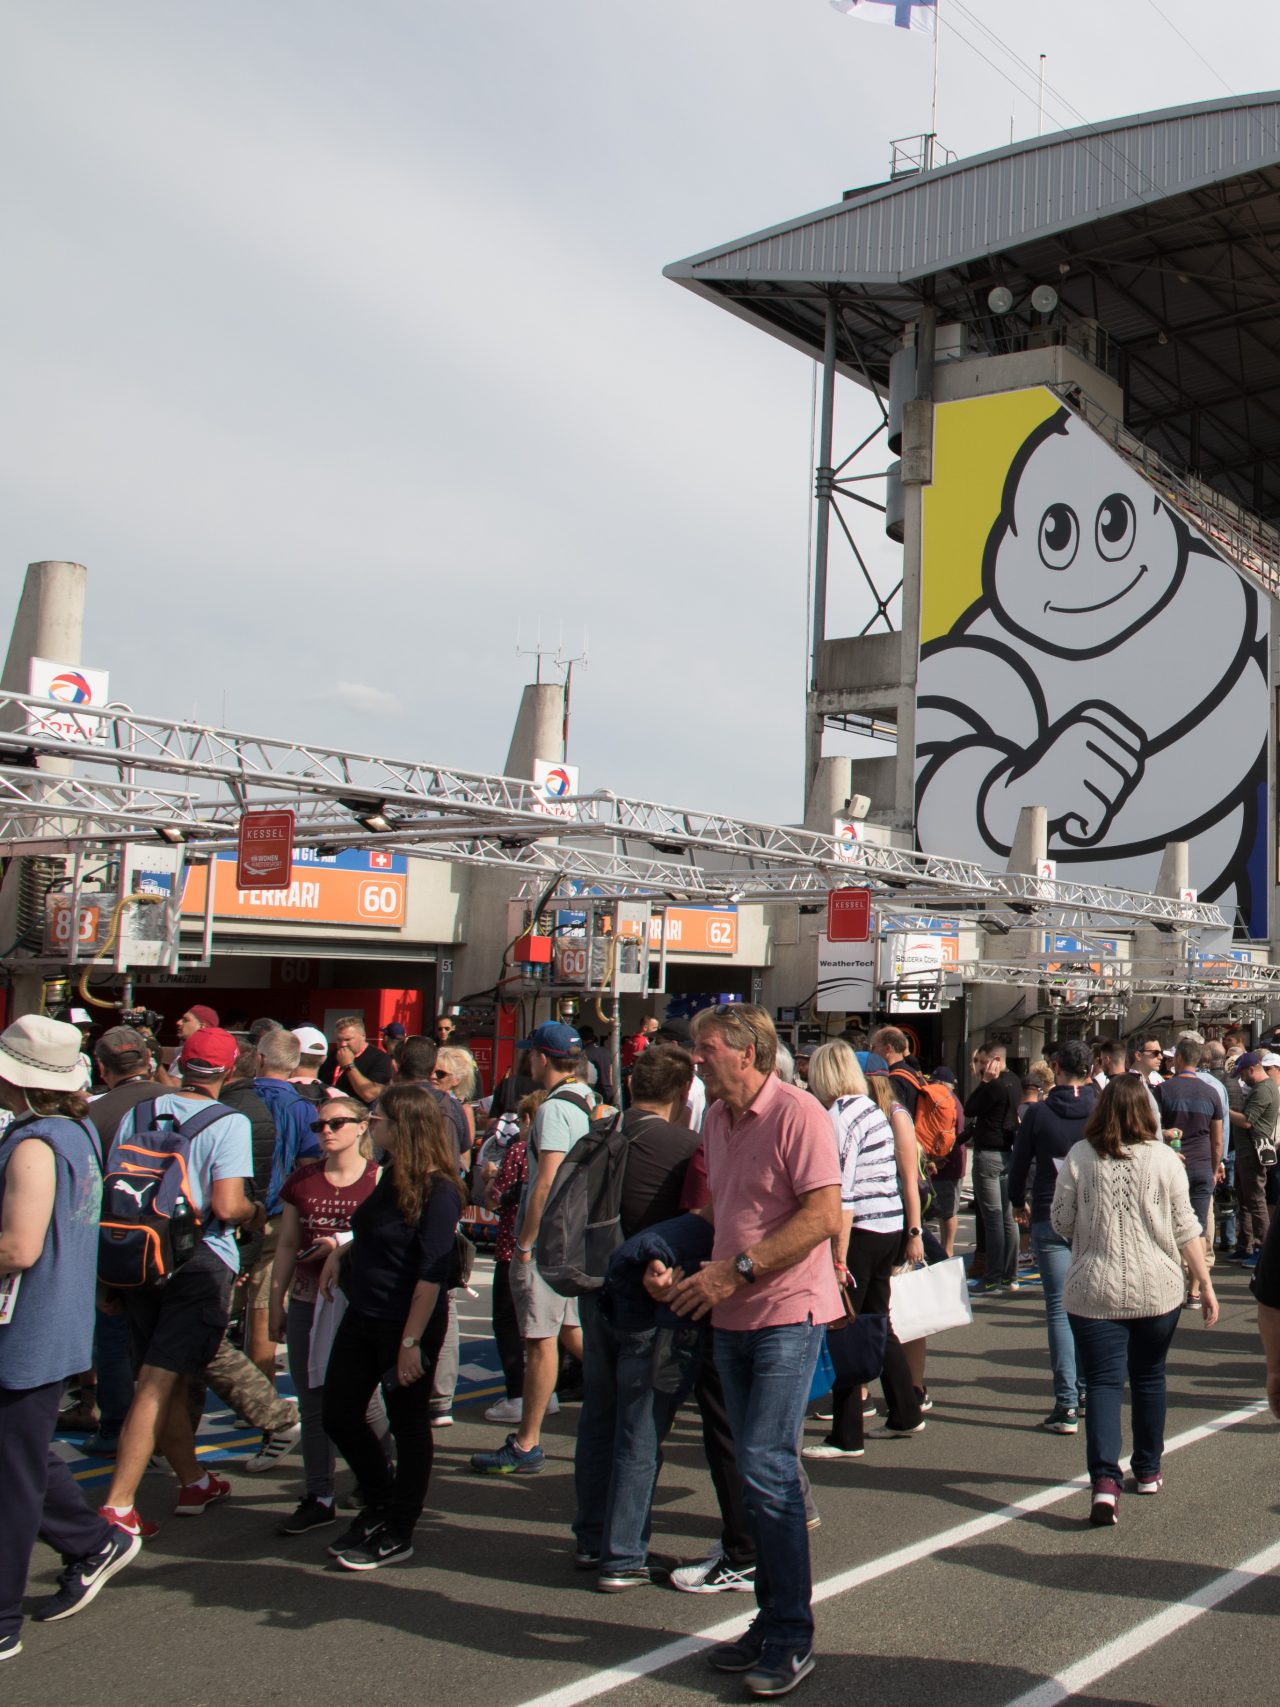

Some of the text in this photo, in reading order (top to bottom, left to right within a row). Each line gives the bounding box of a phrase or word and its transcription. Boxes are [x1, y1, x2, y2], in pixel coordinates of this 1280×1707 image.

[247, 829, 285, 840] KESSEL
[238, 881, 397, 913] FERRARI 60
[710, 923, 732, 944] 62
[281, 958, 310, 983] 60
[443, 961, 453, 972] 51
[562, 951, 587, 974] 60
[820, 960, 875, 968] WeatherTech
[322, 1199, 357, 1207] ALWAYS
